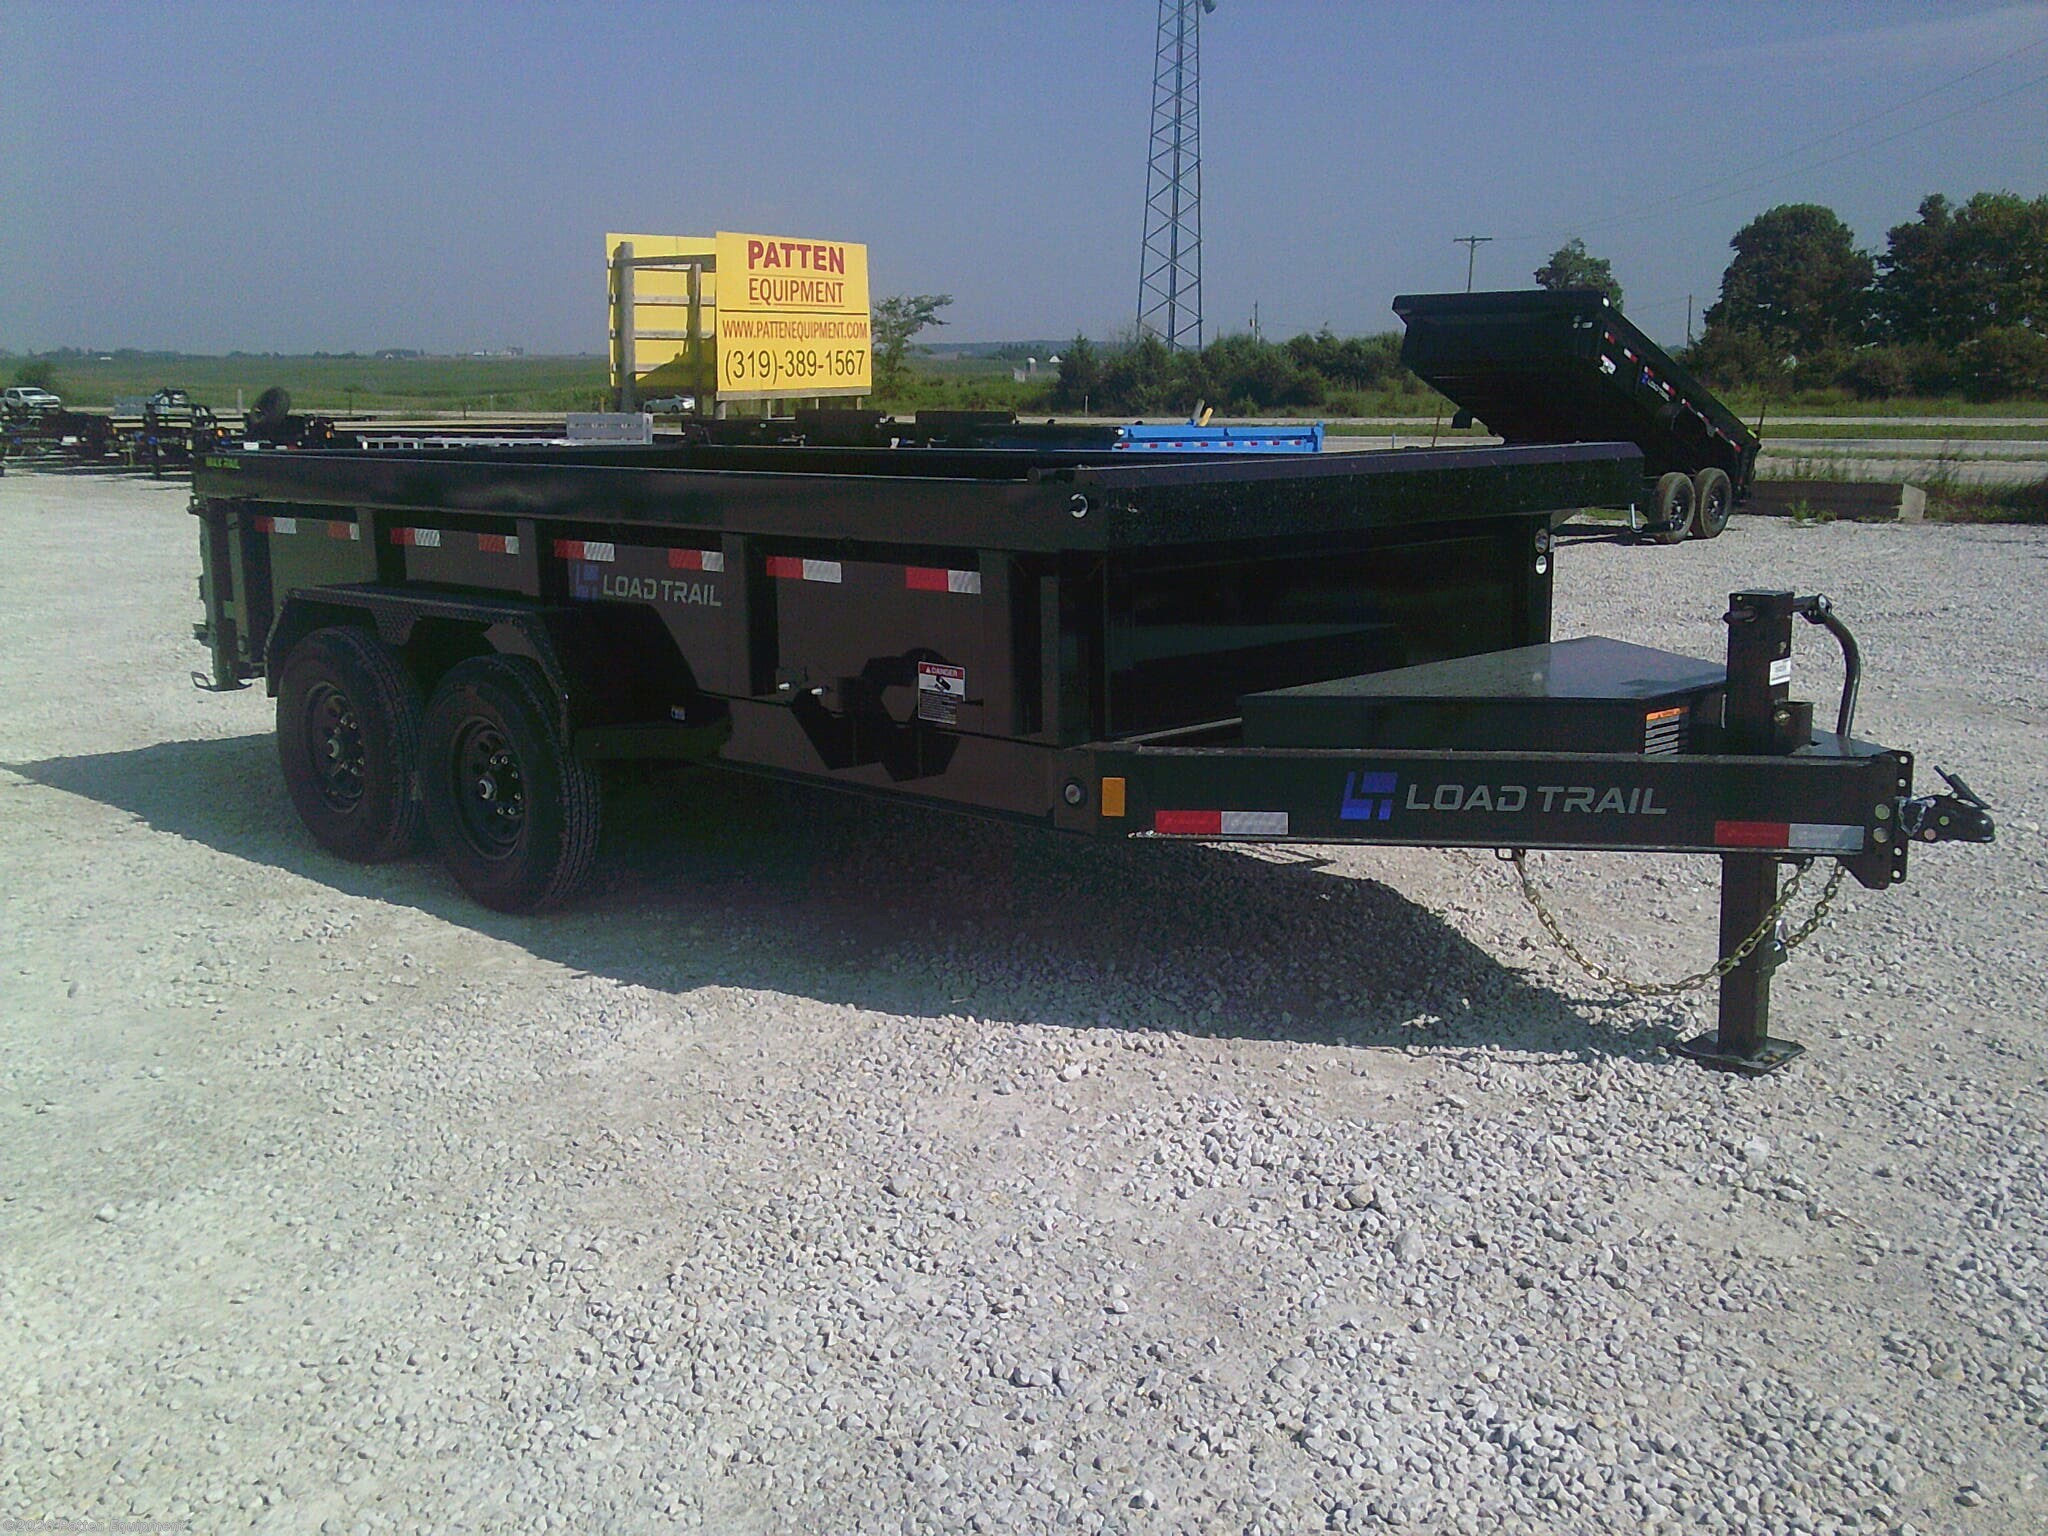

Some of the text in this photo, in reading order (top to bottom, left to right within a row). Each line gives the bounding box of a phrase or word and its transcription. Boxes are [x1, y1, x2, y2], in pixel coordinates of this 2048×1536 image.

[748, 240, 845, 274] PATTEN
[749, 278, 844, 304] EQUIPMENT
[722, 320, 868, 342] WWW.PATTENEQUIPMENT.COM
[725, 350, 866, 385] (319)-389-1567
[602, 574, 657, 600] LOAD
[660, 580, 722, 607] TRAIL
[931, 667, 958, 677] DANGER
[1405, 783, 1528, 812] LOAD
[1536, 786, 1668, 815] TRAIL
